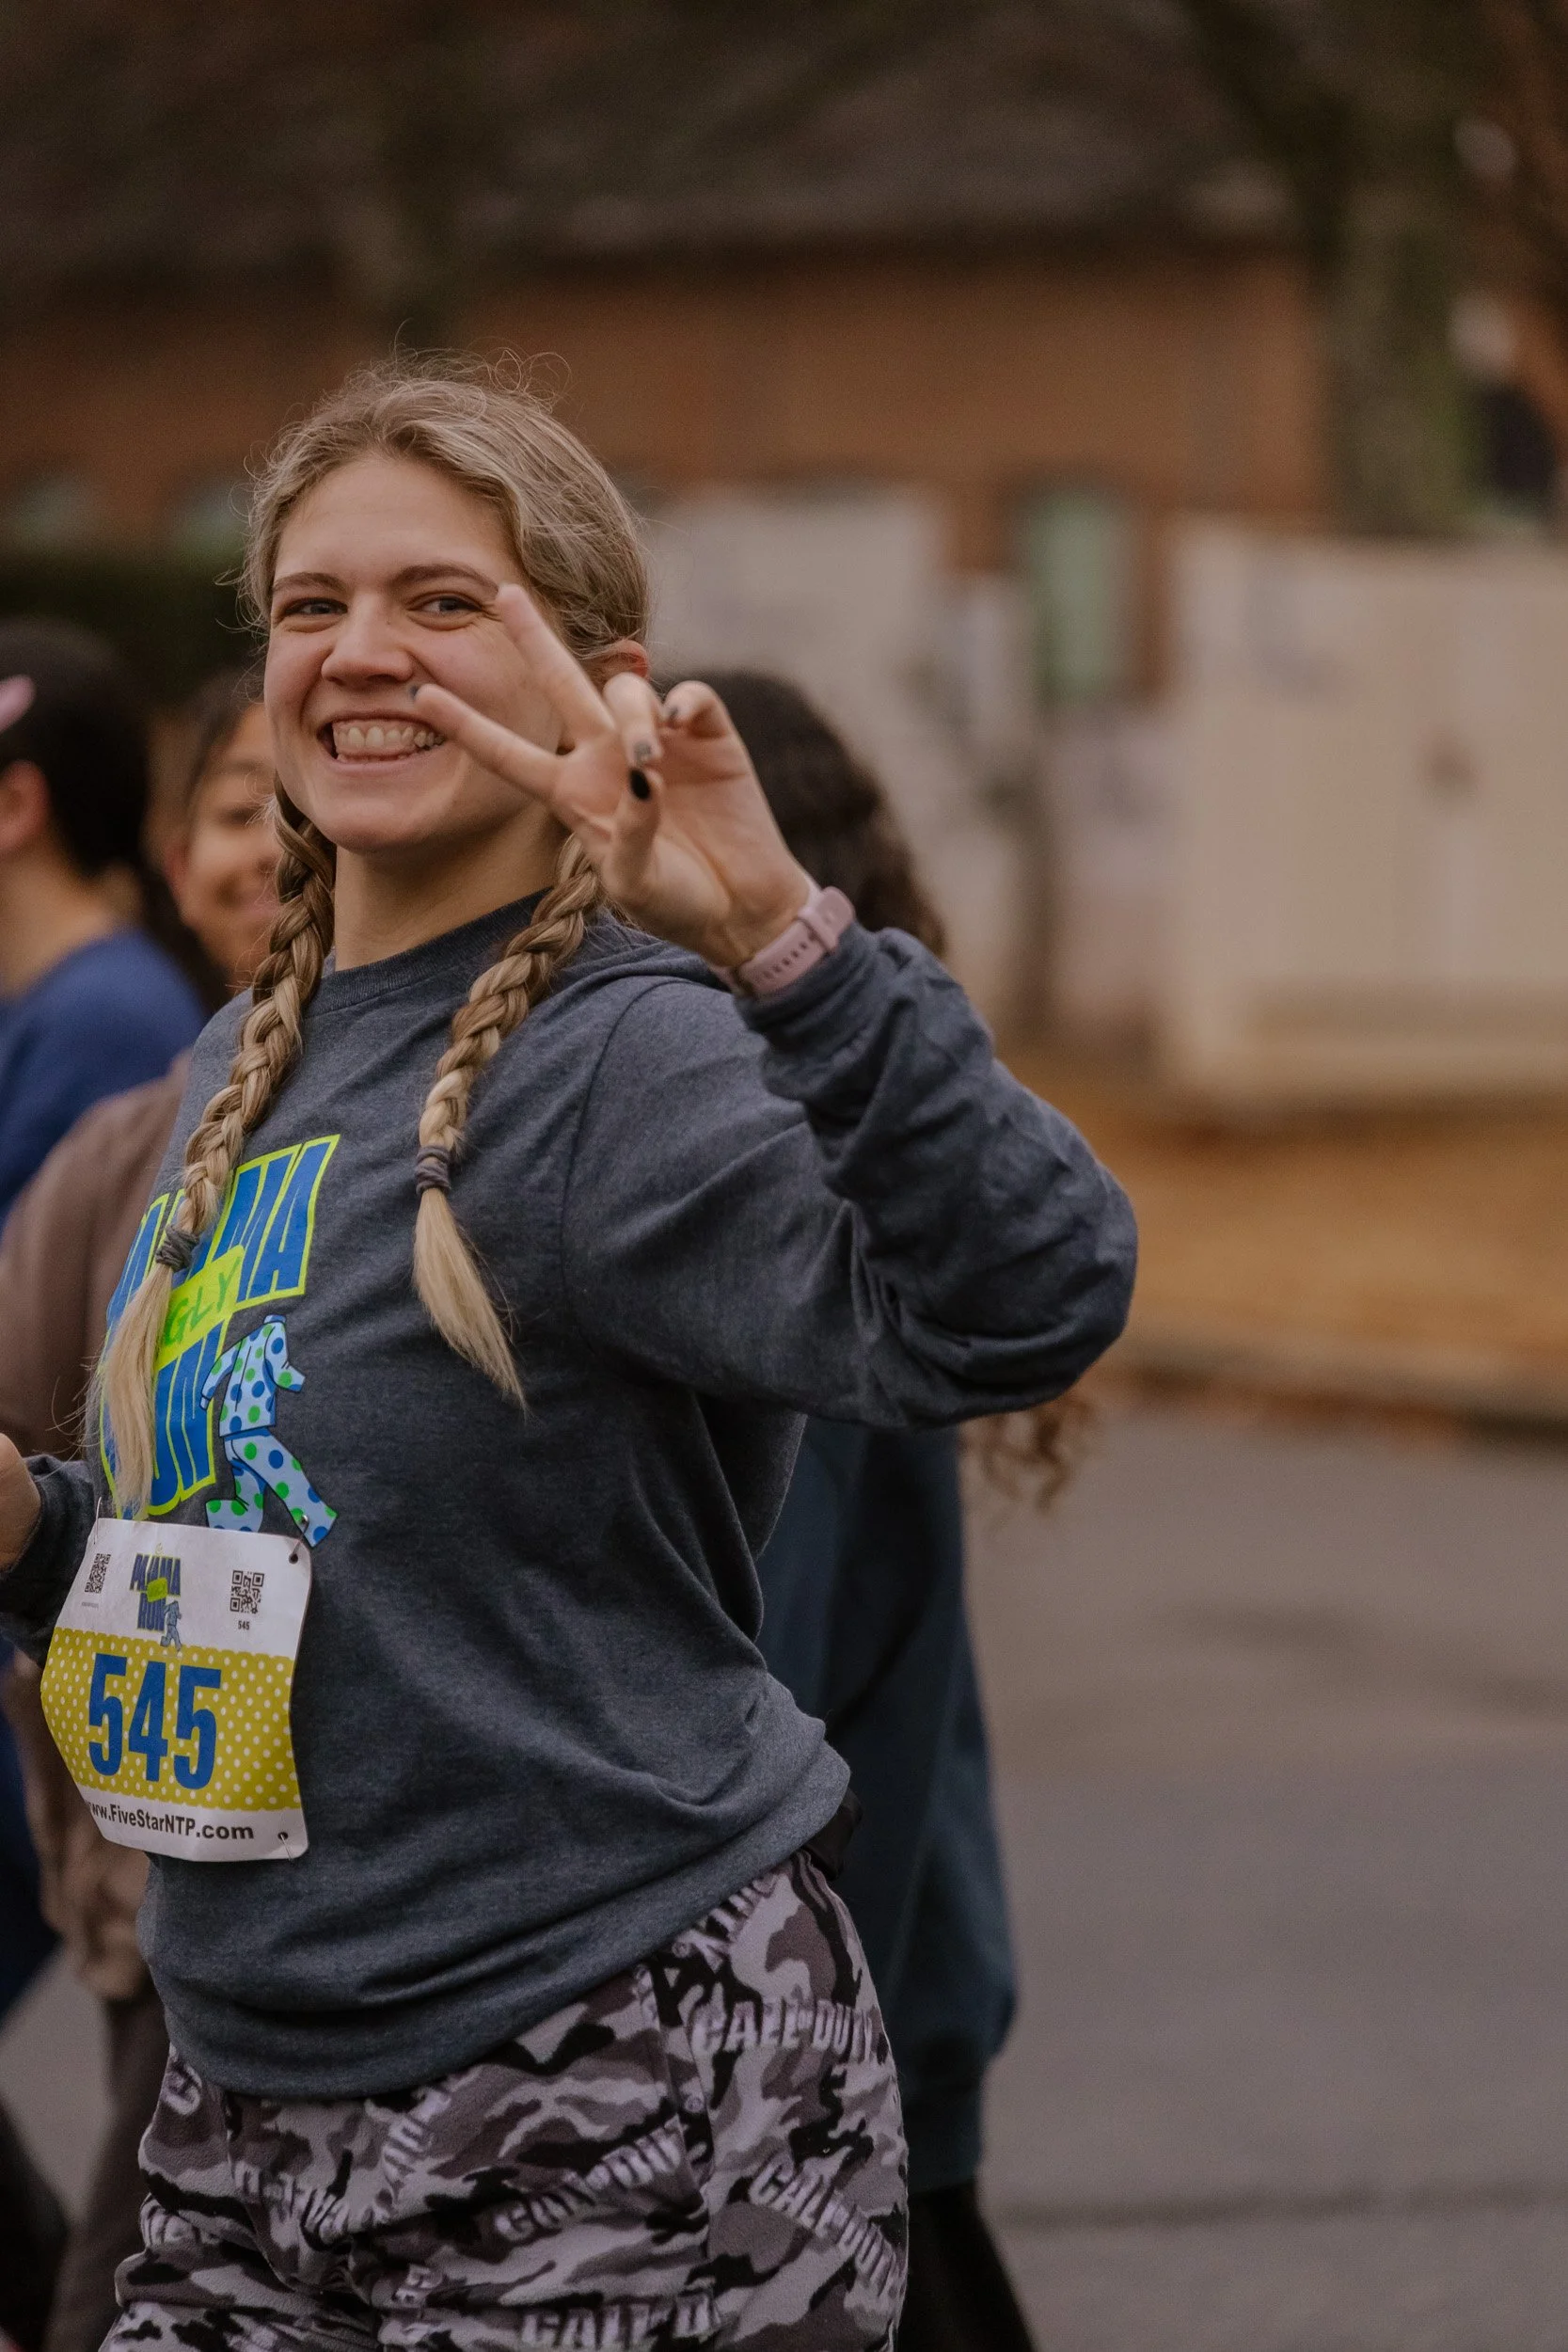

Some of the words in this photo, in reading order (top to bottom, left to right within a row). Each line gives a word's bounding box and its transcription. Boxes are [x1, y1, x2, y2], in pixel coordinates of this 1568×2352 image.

[164, 1256, 242, 1346] GLY
[237, 1619, 251, 1631] 545
[88, 1653, 221, 1789] 545
[87, 1801, 255, 1839] ww.FiveStarNTP.com
